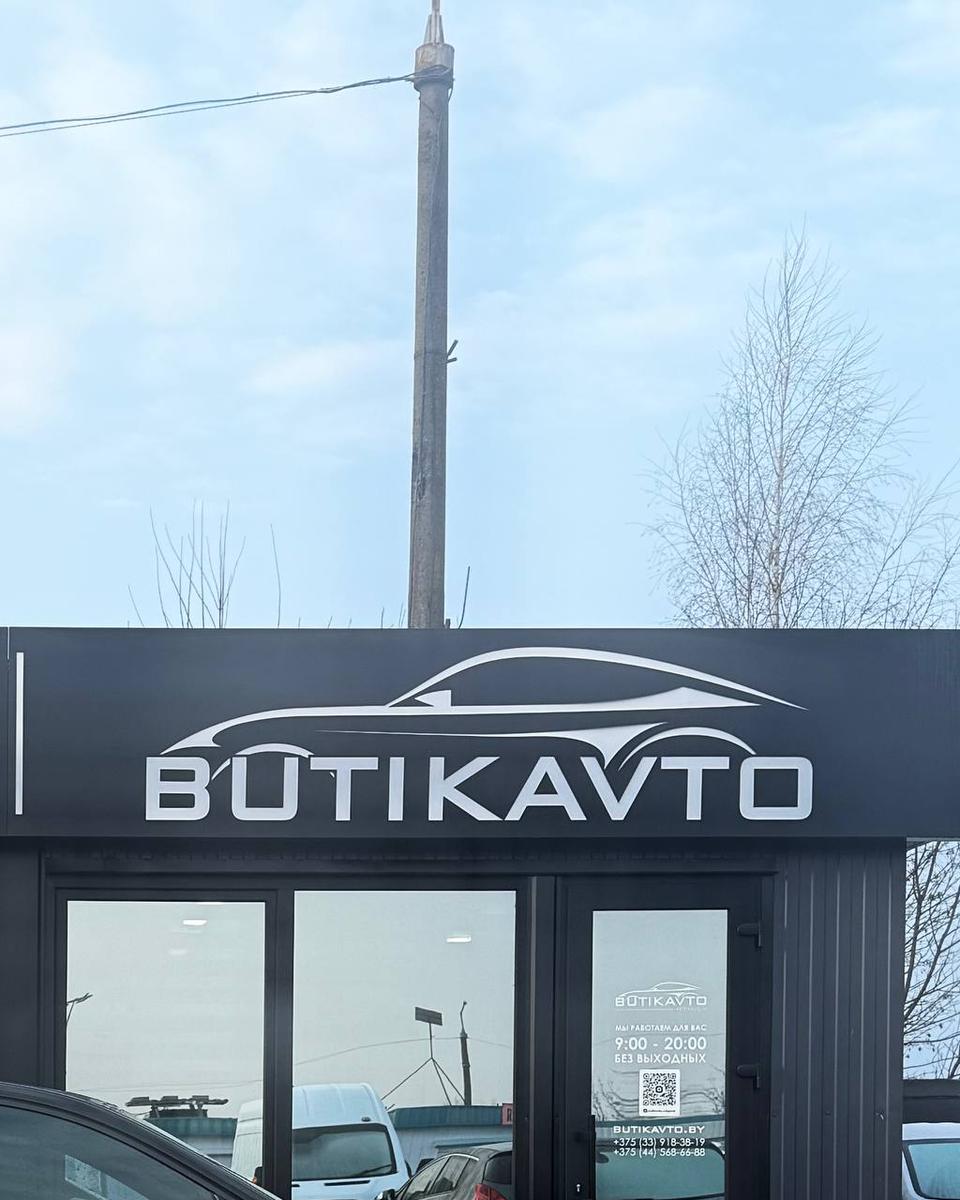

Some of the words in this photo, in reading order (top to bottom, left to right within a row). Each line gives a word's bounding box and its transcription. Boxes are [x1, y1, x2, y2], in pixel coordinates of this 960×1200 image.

[145, 755, 814, 822] BUTIKAVTO
[615, 995, 707, 1007] BUTIKAVTO
[615, 1023, 629, 1032] МЫ
[630, 1023, 672, 1032] РАБОТАЕМ
[672, 1023, 689, 1032] ДЛЯ
[690, 1023, 708, 1032] ВАС
[614, 1036, 648, 1051] 9:00
[664, 1036, 707, 1050] 20:00
[614, 1053, 634, 1064] БЕЗ
[636, 1053, 707, 1065] ВЫХОДНЫХ
[613, 1125, 706, 1134] BUTIKAVTO.BY
[613, 1137, 637, 1147] +375
[638, 1137, 657, 1149] (33)
[659, 1137, 706, 1147] 918-38-19
[613, 1147, 637, 1157] +375
[638, 1147, 657, 1159] (44)
[659, 1147, 706, 1157] 568-66-88
